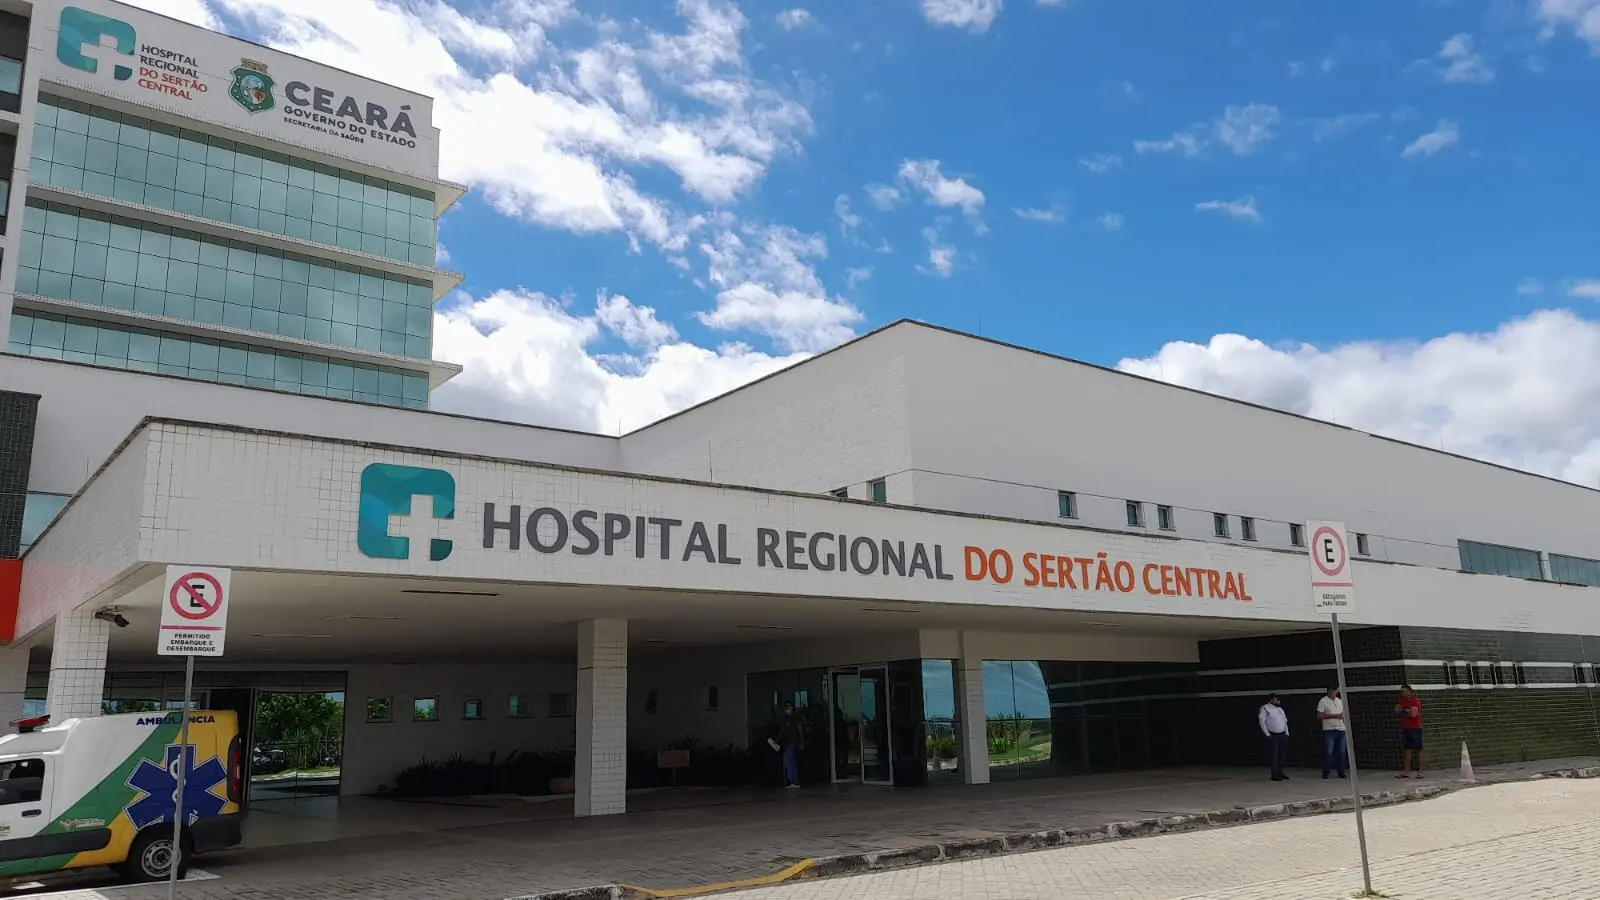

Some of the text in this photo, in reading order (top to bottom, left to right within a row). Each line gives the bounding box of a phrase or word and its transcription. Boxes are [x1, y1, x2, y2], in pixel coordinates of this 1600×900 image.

[139, 54, 200, 79] REGIONAL
[141, 43, 199, 67] HOSPITAL
[138, 78, 193, 101] CENTRAL
[139, 66, 208, 93] DO SERTÃO
[285, 81, 417, 138] CEARÁ
[283, 105, 416, 149] GOVERNO DO ESTADO
[283, 116, 364, 144] SECRETARIA DA SAÚDE
[482, 502, 1253, 601] HOSPITAL REGIONAL DO SERTÃO CENTRAL
[1324, 538, 1335, 563] E
[190, 584, 205, 607] E
